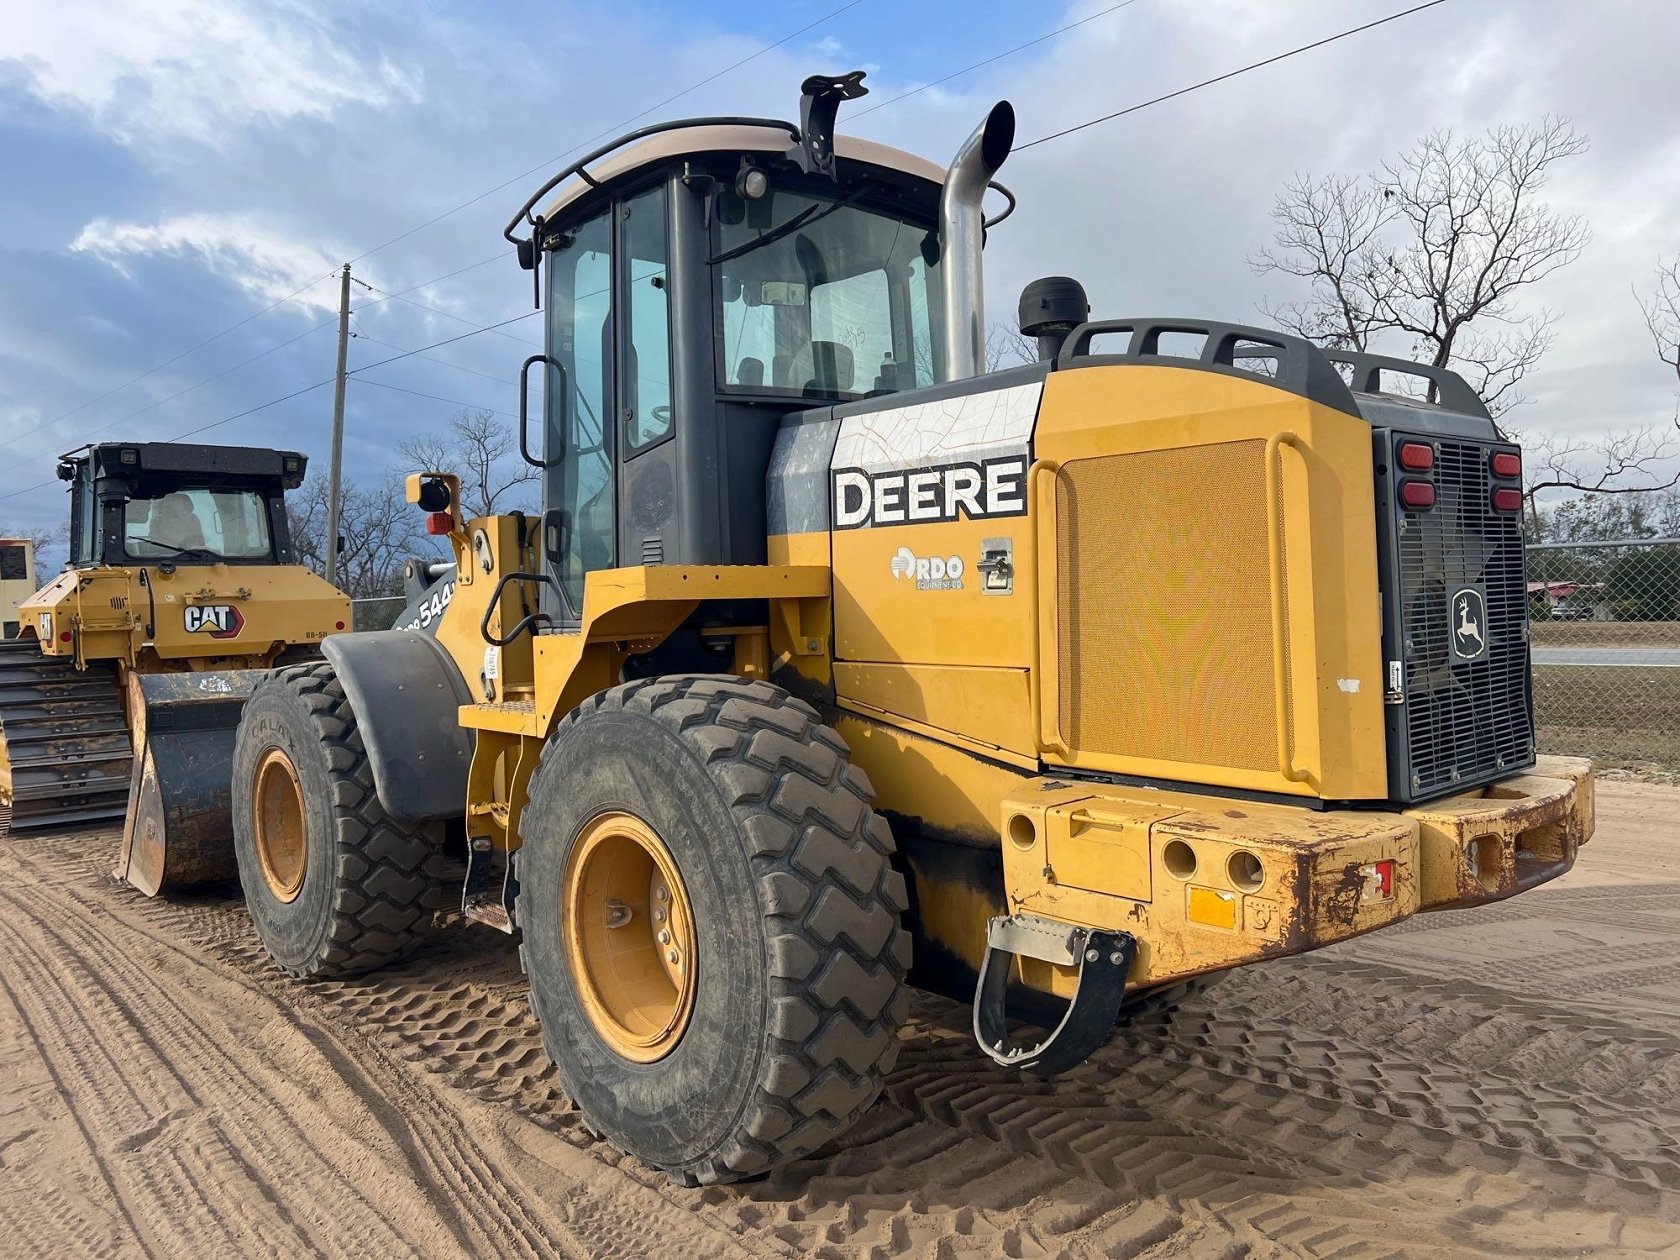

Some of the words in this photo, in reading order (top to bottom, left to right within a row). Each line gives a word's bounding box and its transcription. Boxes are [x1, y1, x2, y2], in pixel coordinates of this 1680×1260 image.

[834, 460, 1024, 527] DEERE
[916, 555, 964, 580] RDO
[184, 606, 230, 632] CAT
[419, 581, 456, 628] 544
